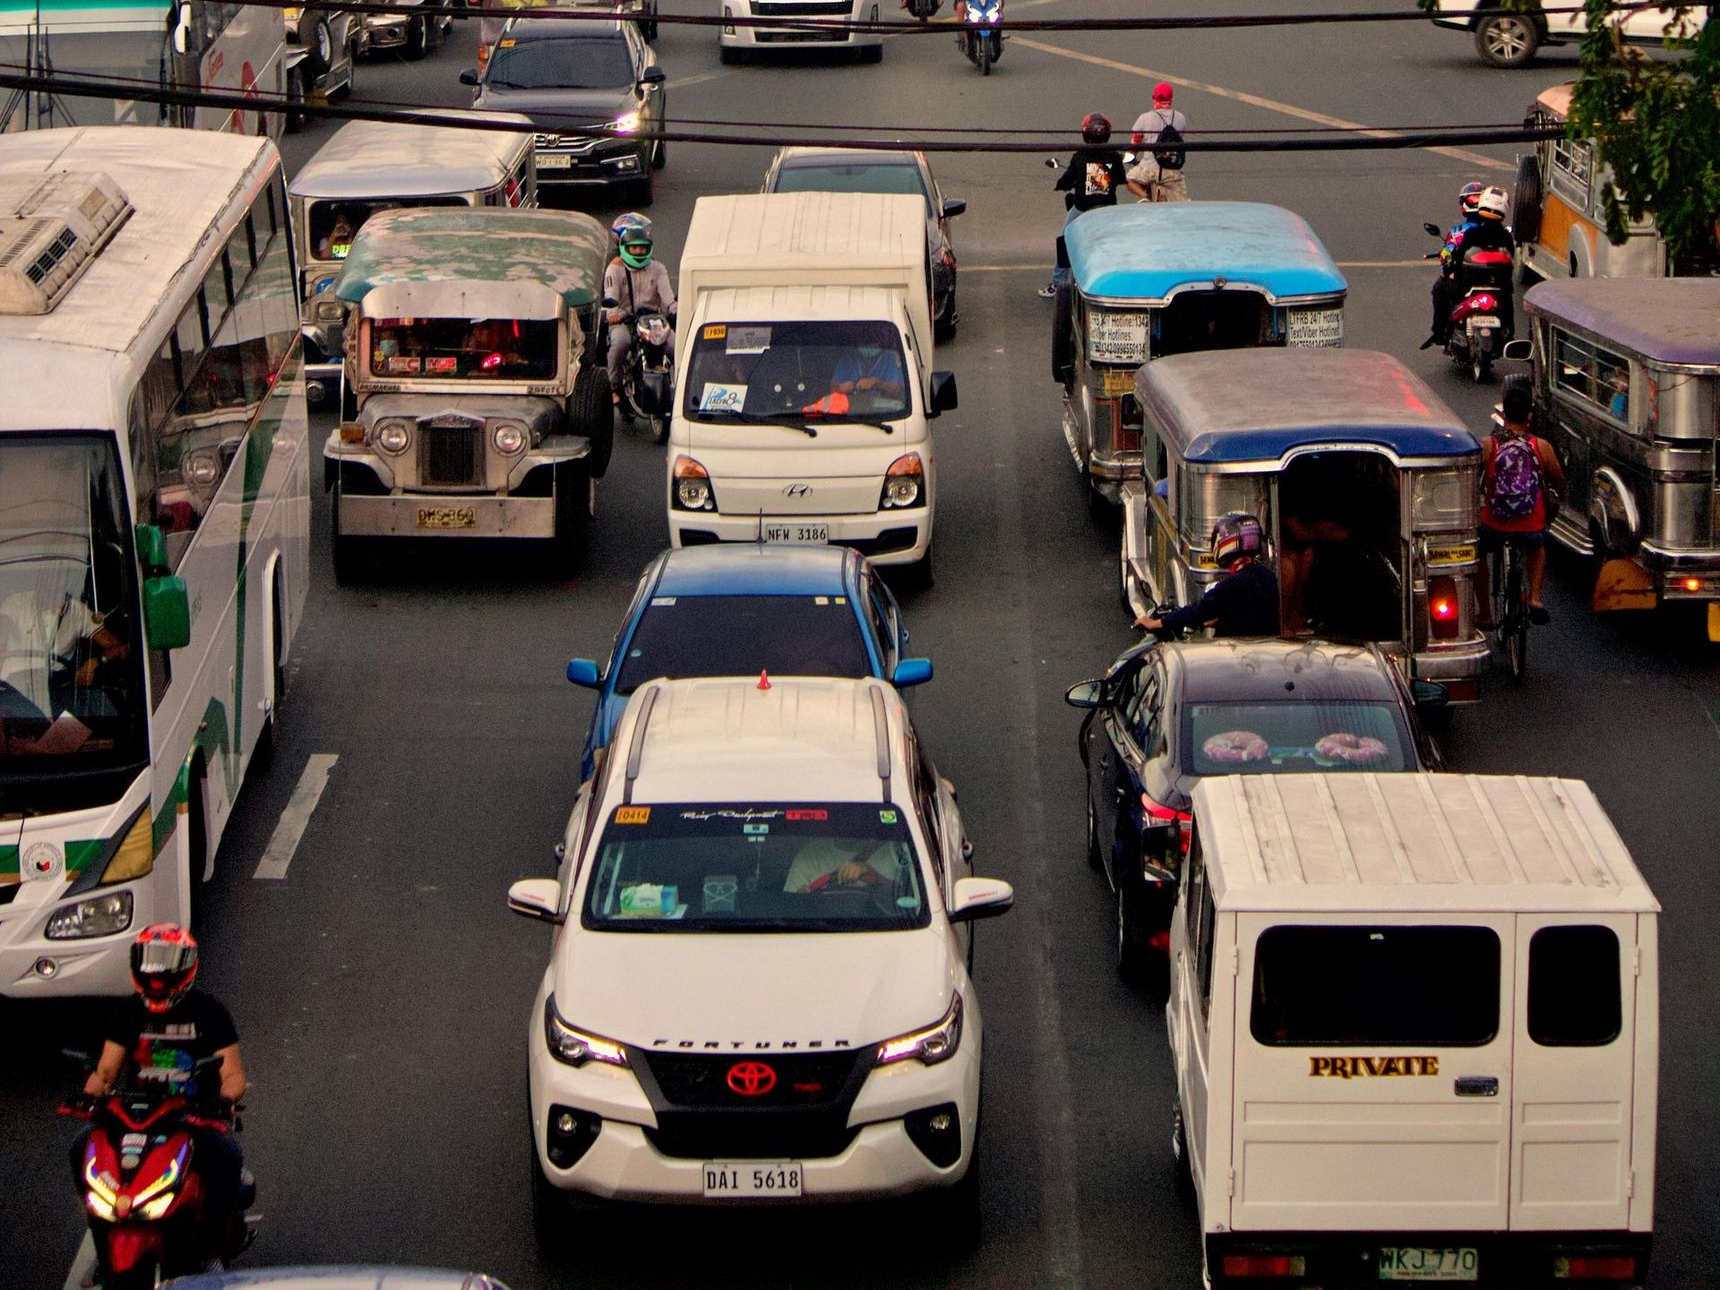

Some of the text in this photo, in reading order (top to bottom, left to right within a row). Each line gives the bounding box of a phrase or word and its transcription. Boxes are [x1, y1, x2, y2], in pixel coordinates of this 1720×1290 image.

[768, 528, 827, 541] NFW 3186
[622, 810, 648, 821] 0414
[652, 1039, 851, 1049] FORTUNER
[1309, 1055, 1440, 1079] PRIVATE
[706, 1171, 799, 1190] DAI 5618
[1381, 1250, 1476, 1270] WKJ 770
